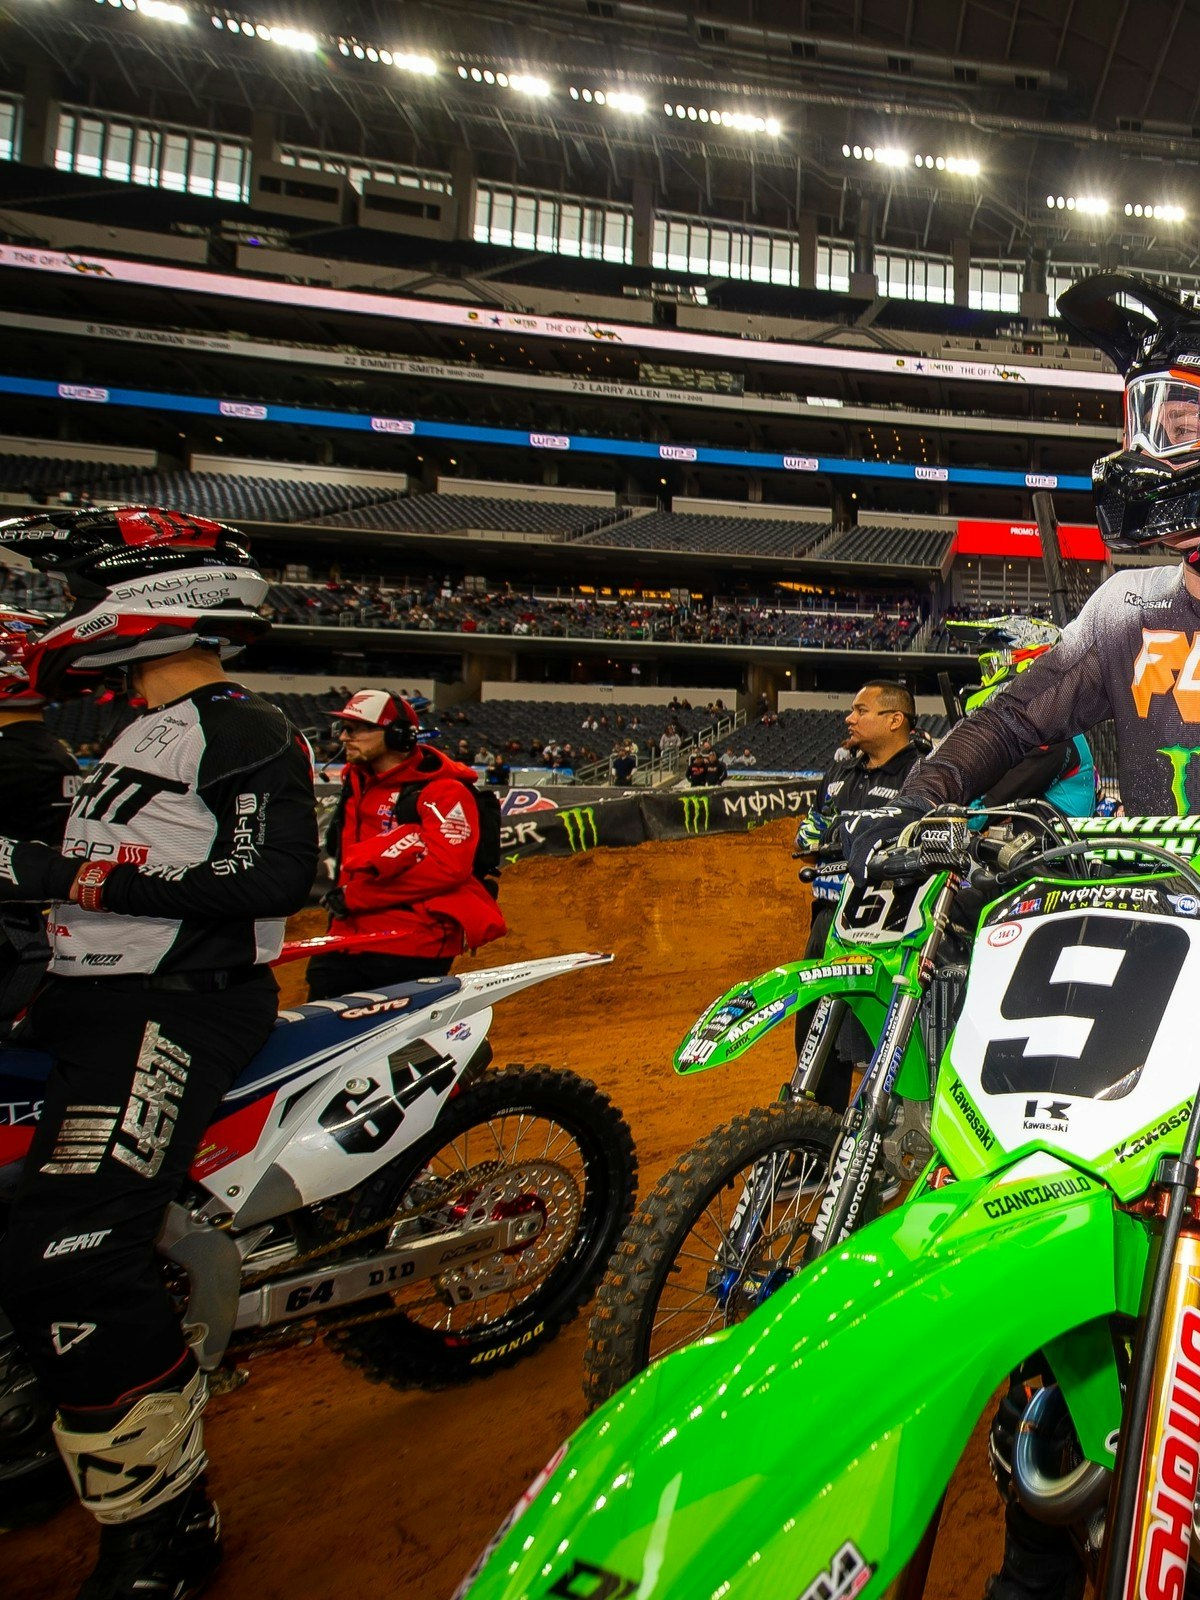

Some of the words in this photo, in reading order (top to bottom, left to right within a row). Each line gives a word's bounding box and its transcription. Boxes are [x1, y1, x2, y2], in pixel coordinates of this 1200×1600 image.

[1142, 333, 1158, 346] FOX
[572, 381, 585, 391] 73
[588, 383, 624, 396] LARRY
[626, 387, 660, 398] ALLEN
[1010, 527, 1034, 536] PROMO
[146, 587, 230, 609] bullfrog
[78, 614, 113, 637] SHOEI
[723, 789, 819, 818] MONST
[921, 829, 951, 841] ARC
[820, 862, 849, 874] ARC
[1060, 885, 1160, 904] MONSTER
[799, 963, 875, 983] BABBITT'S
[341, 997, 411, 1019] GUTS
[726, 1000, 785, 1042] MAXXIS
[981, 915, 1190, 1100] 9
[317, 1037, 458, 1155] 64
[949, 1078, 995, 1151] Kawasaki
[1023, 1119, 1069, 1133] Kawasaki
[811, 1136, 856, 1243] MAXXIS
[847, 1132, 883, 1228] MOTOSTUFF
[983, 1176, 1092, 1219] CIANCIARULO
[43, 1229, 113, 1259] LEATT
[368, 1260, 416, 1287] DID
[285, 1279, 336, 1313] 64
[470, 1320, 545, 1365] DUNLOP
